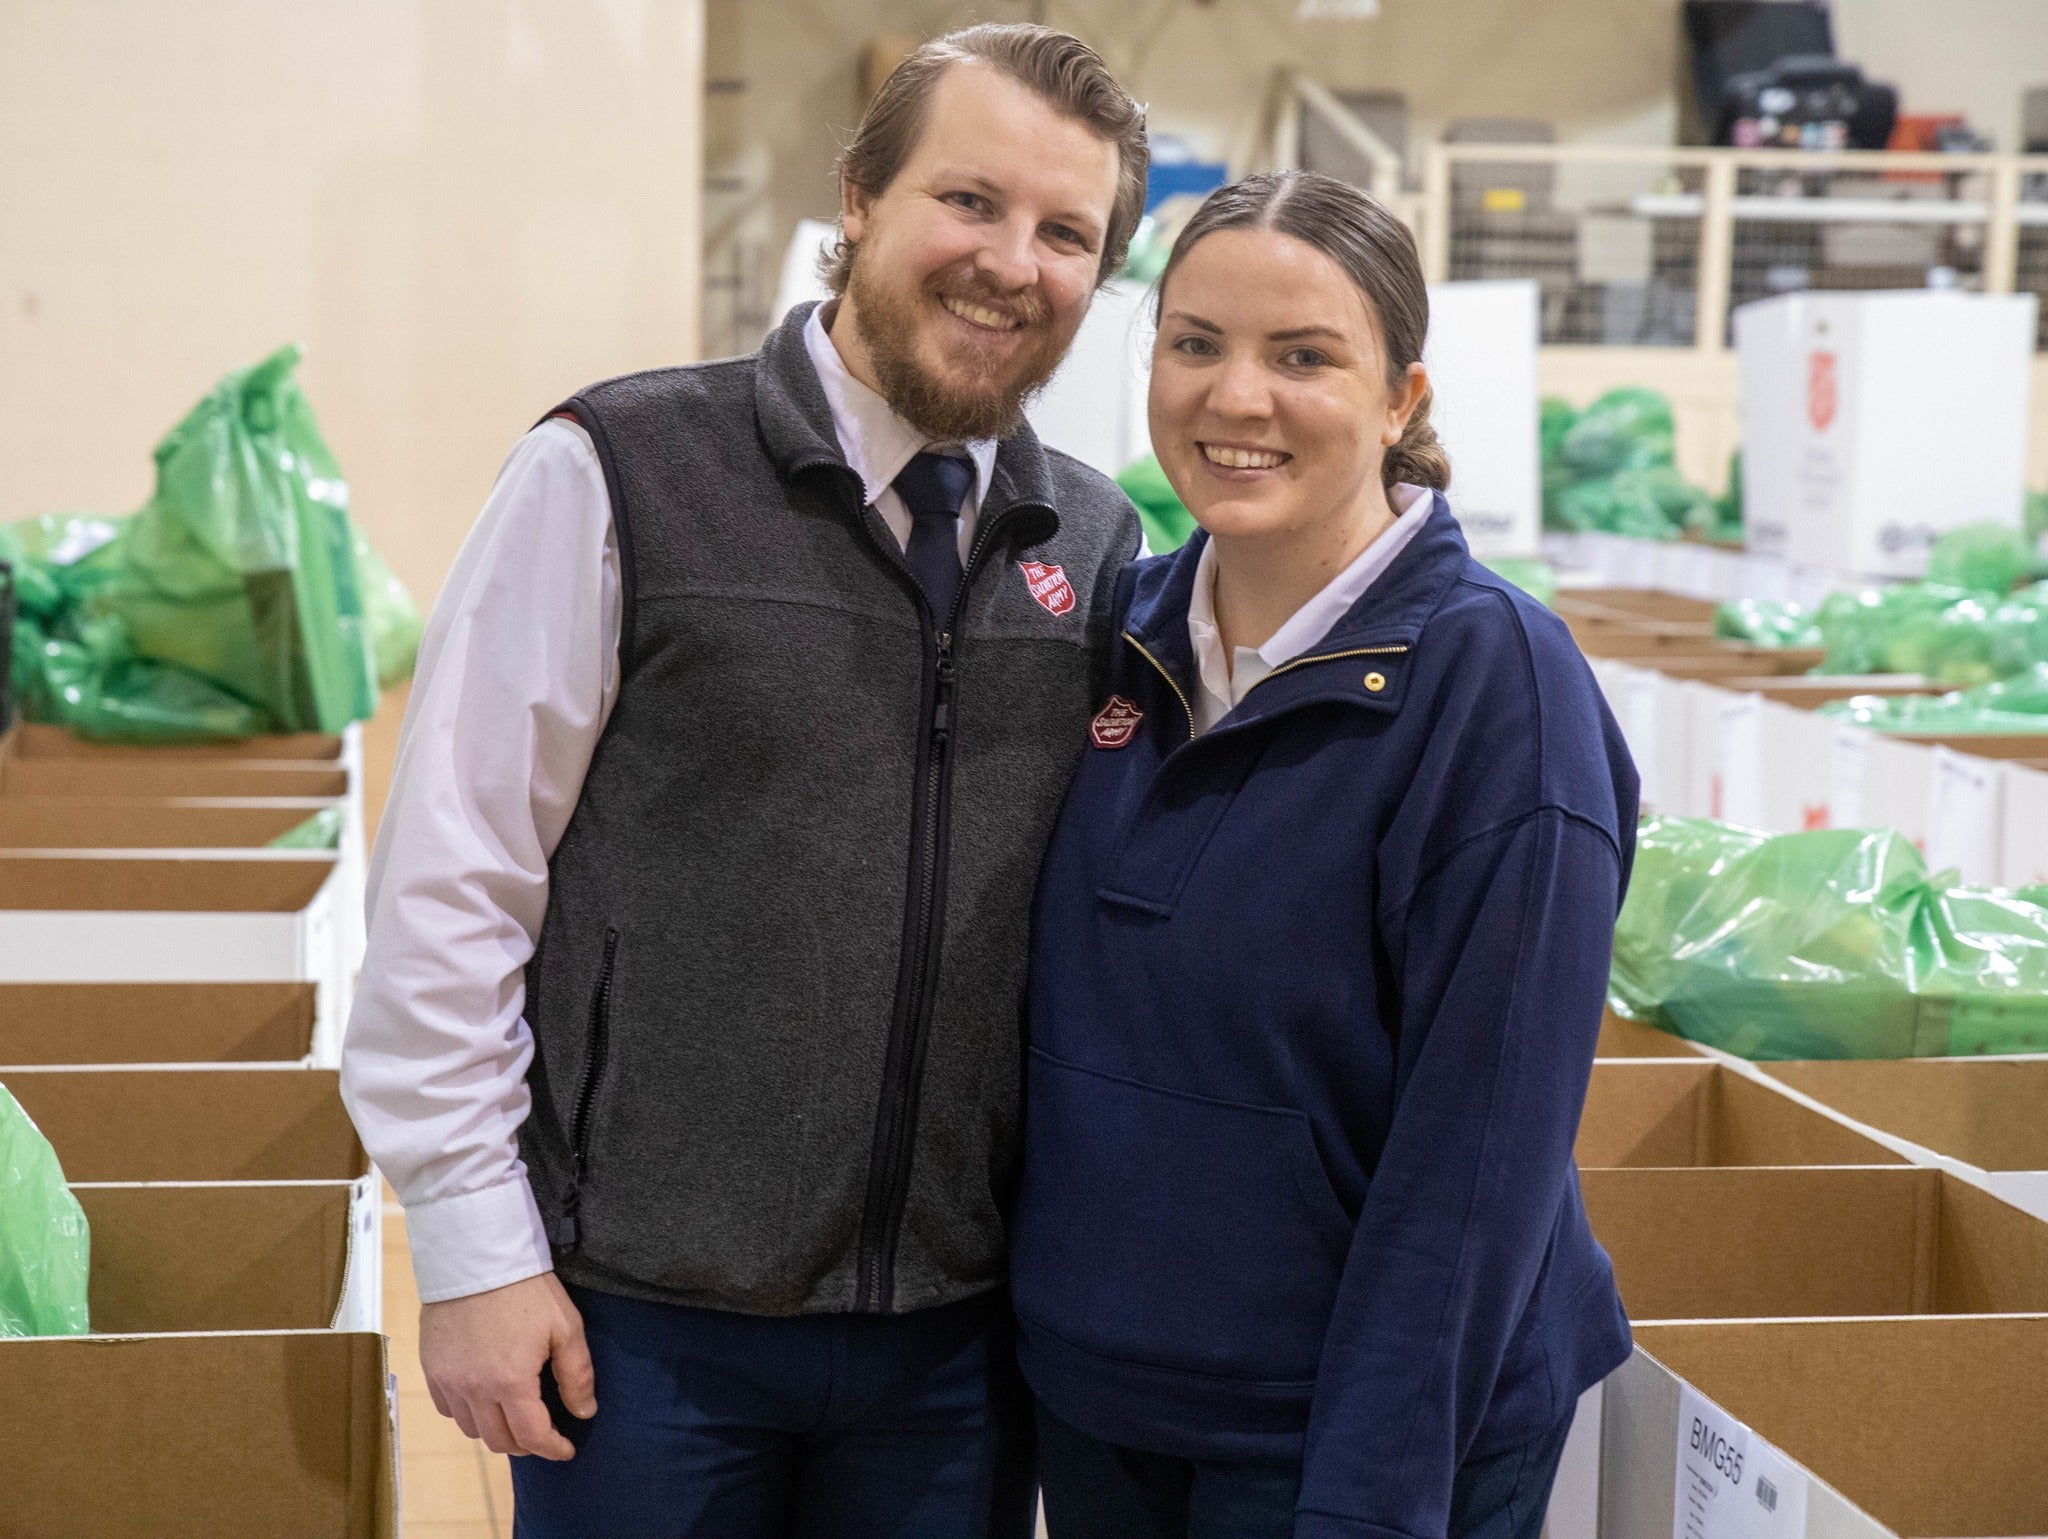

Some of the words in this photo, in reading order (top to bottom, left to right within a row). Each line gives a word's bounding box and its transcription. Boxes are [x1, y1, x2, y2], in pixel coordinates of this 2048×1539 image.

[1028, 566, 1047, 580] THE
[1047, 585, 1069, 609] ARMY
[1690, 1416, 1743, 1485] BMG55
